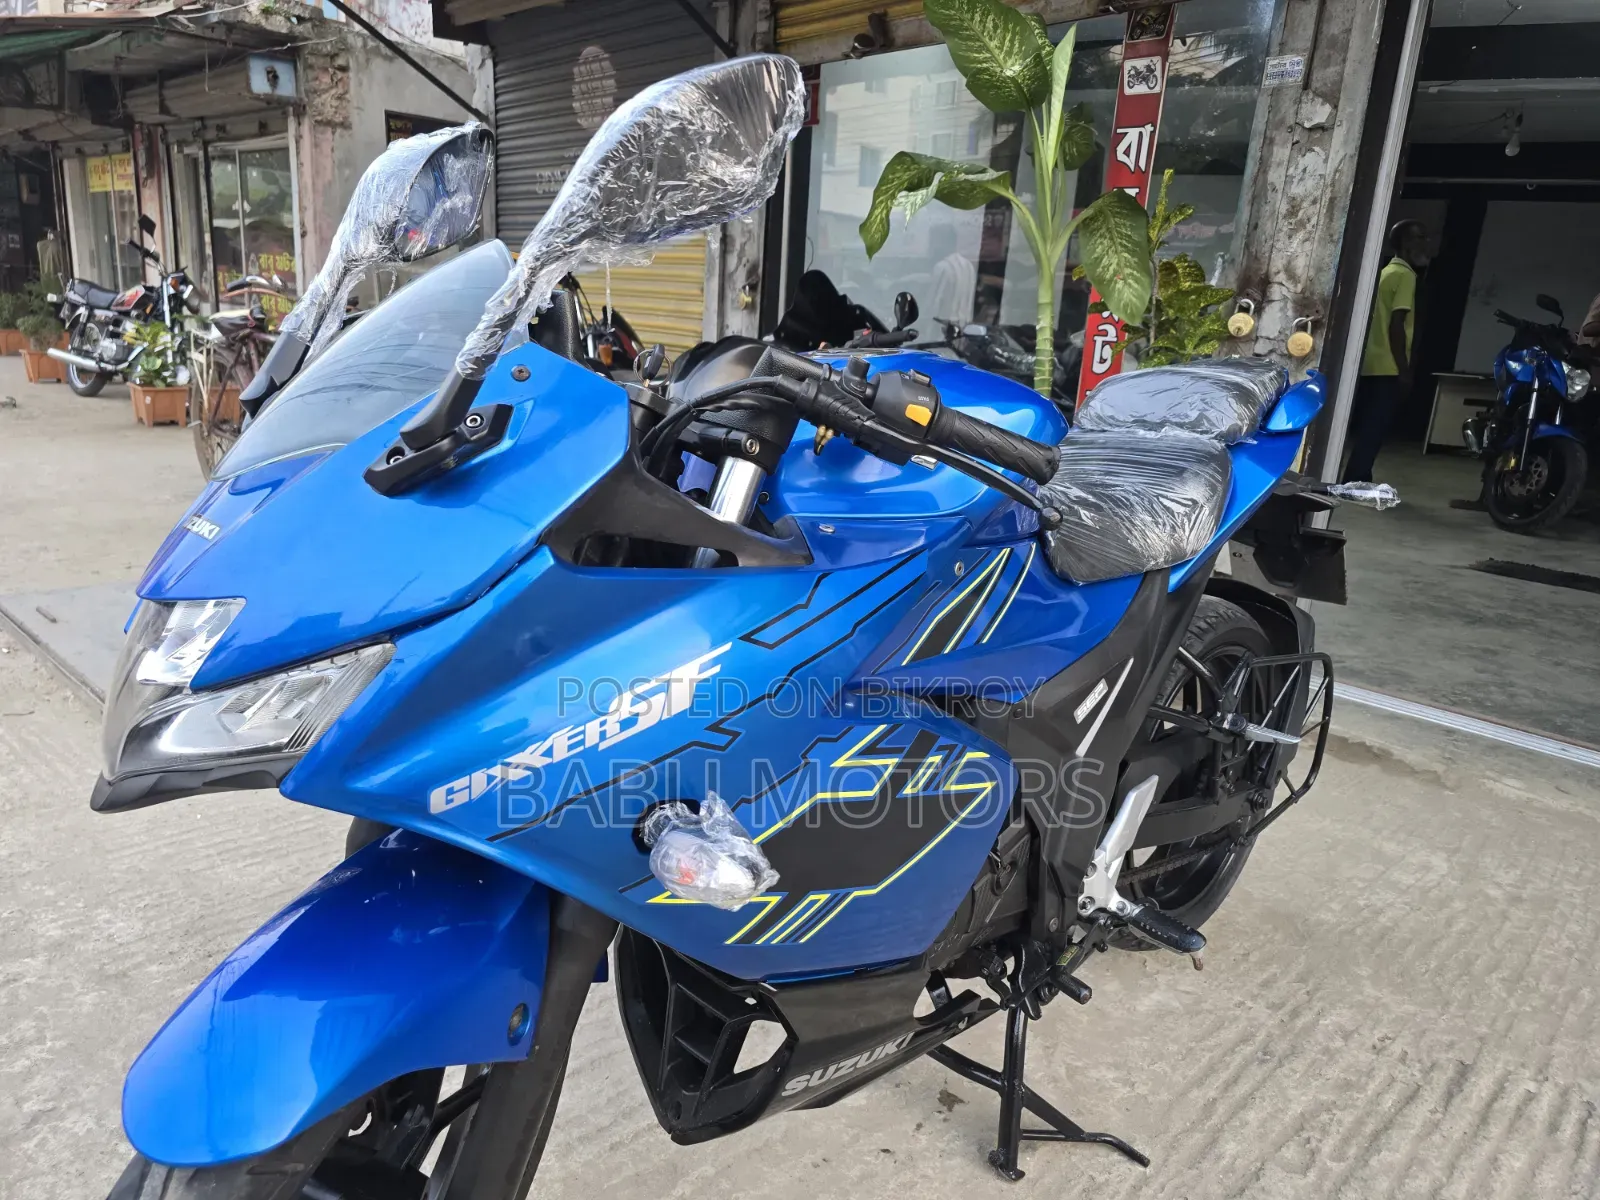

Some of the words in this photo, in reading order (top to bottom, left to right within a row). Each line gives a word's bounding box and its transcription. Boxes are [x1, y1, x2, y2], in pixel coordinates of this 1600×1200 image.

[185, 515, 221, 540] ZUKI
[1077, 682, 1106, 721] SEP
[781, 1031, 916, 1097] SUZUKI
